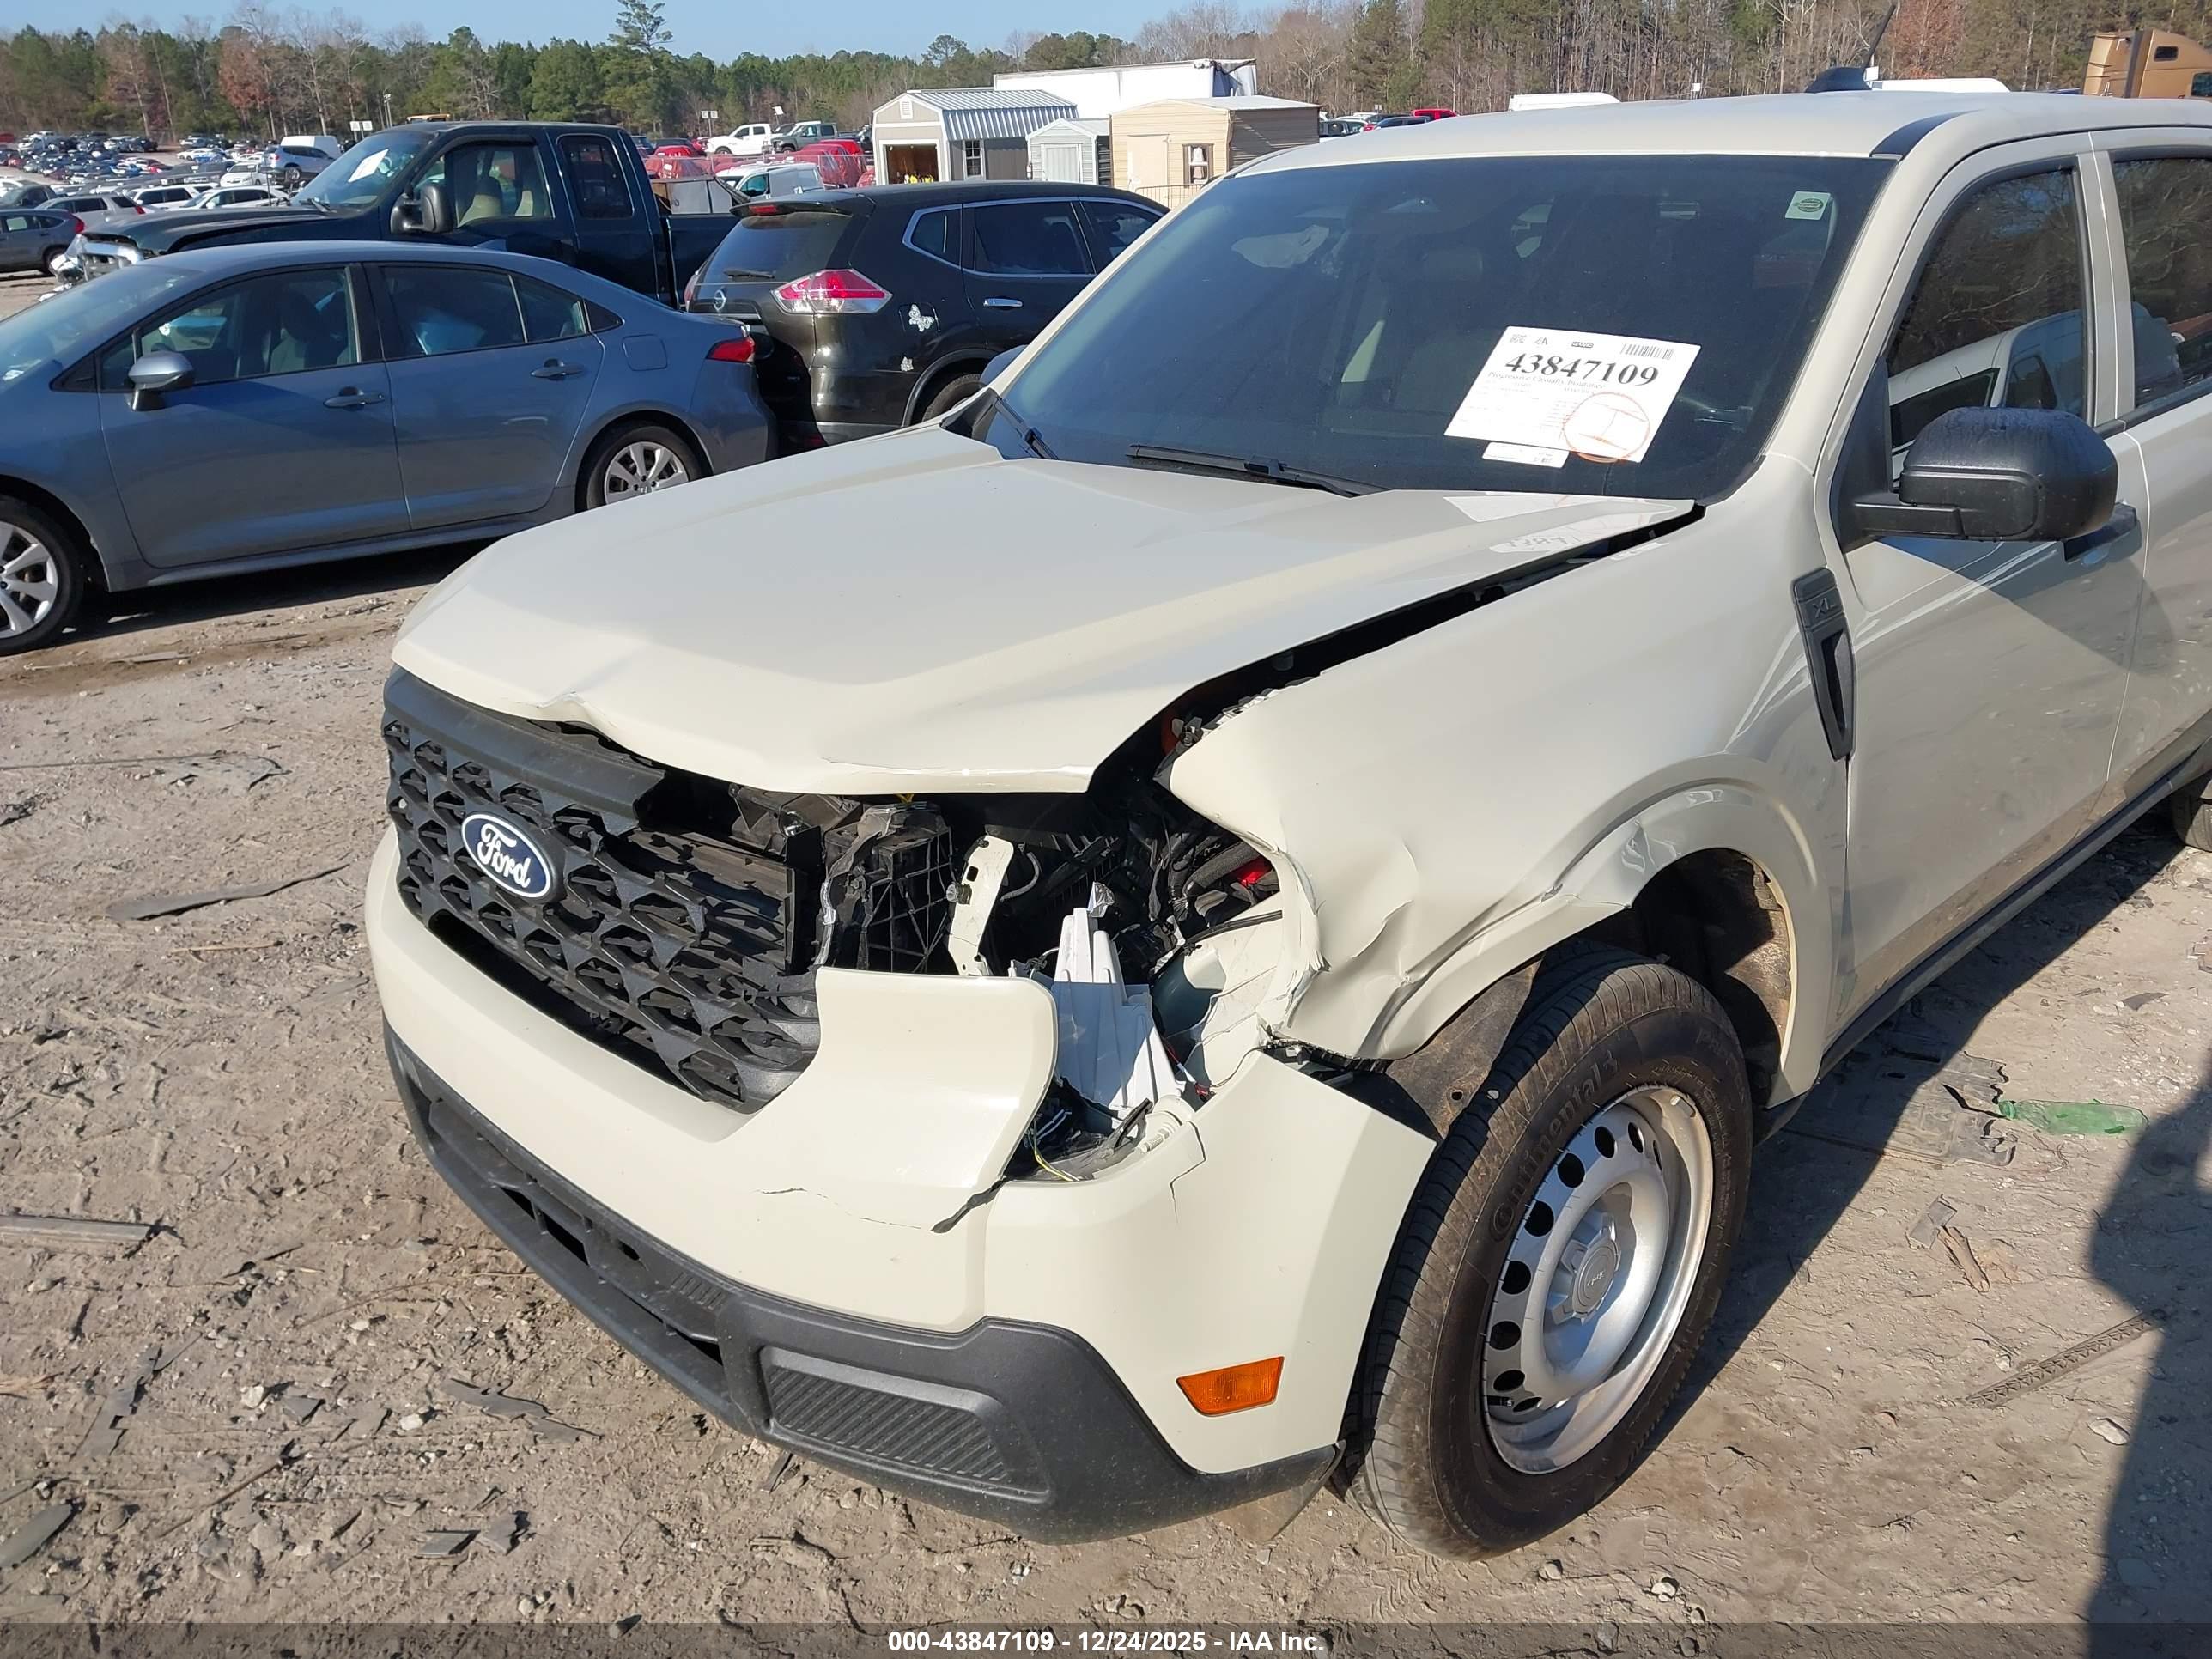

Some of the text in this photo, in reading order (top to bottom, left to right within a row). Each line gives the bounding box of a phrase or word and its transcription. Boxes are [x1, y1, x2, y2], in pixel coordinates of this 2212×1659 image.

[1505, 353, 1659, 386] 43847109
[1812, 597, 1836, 618] XL
[477, 823, 531, 888] Ford
